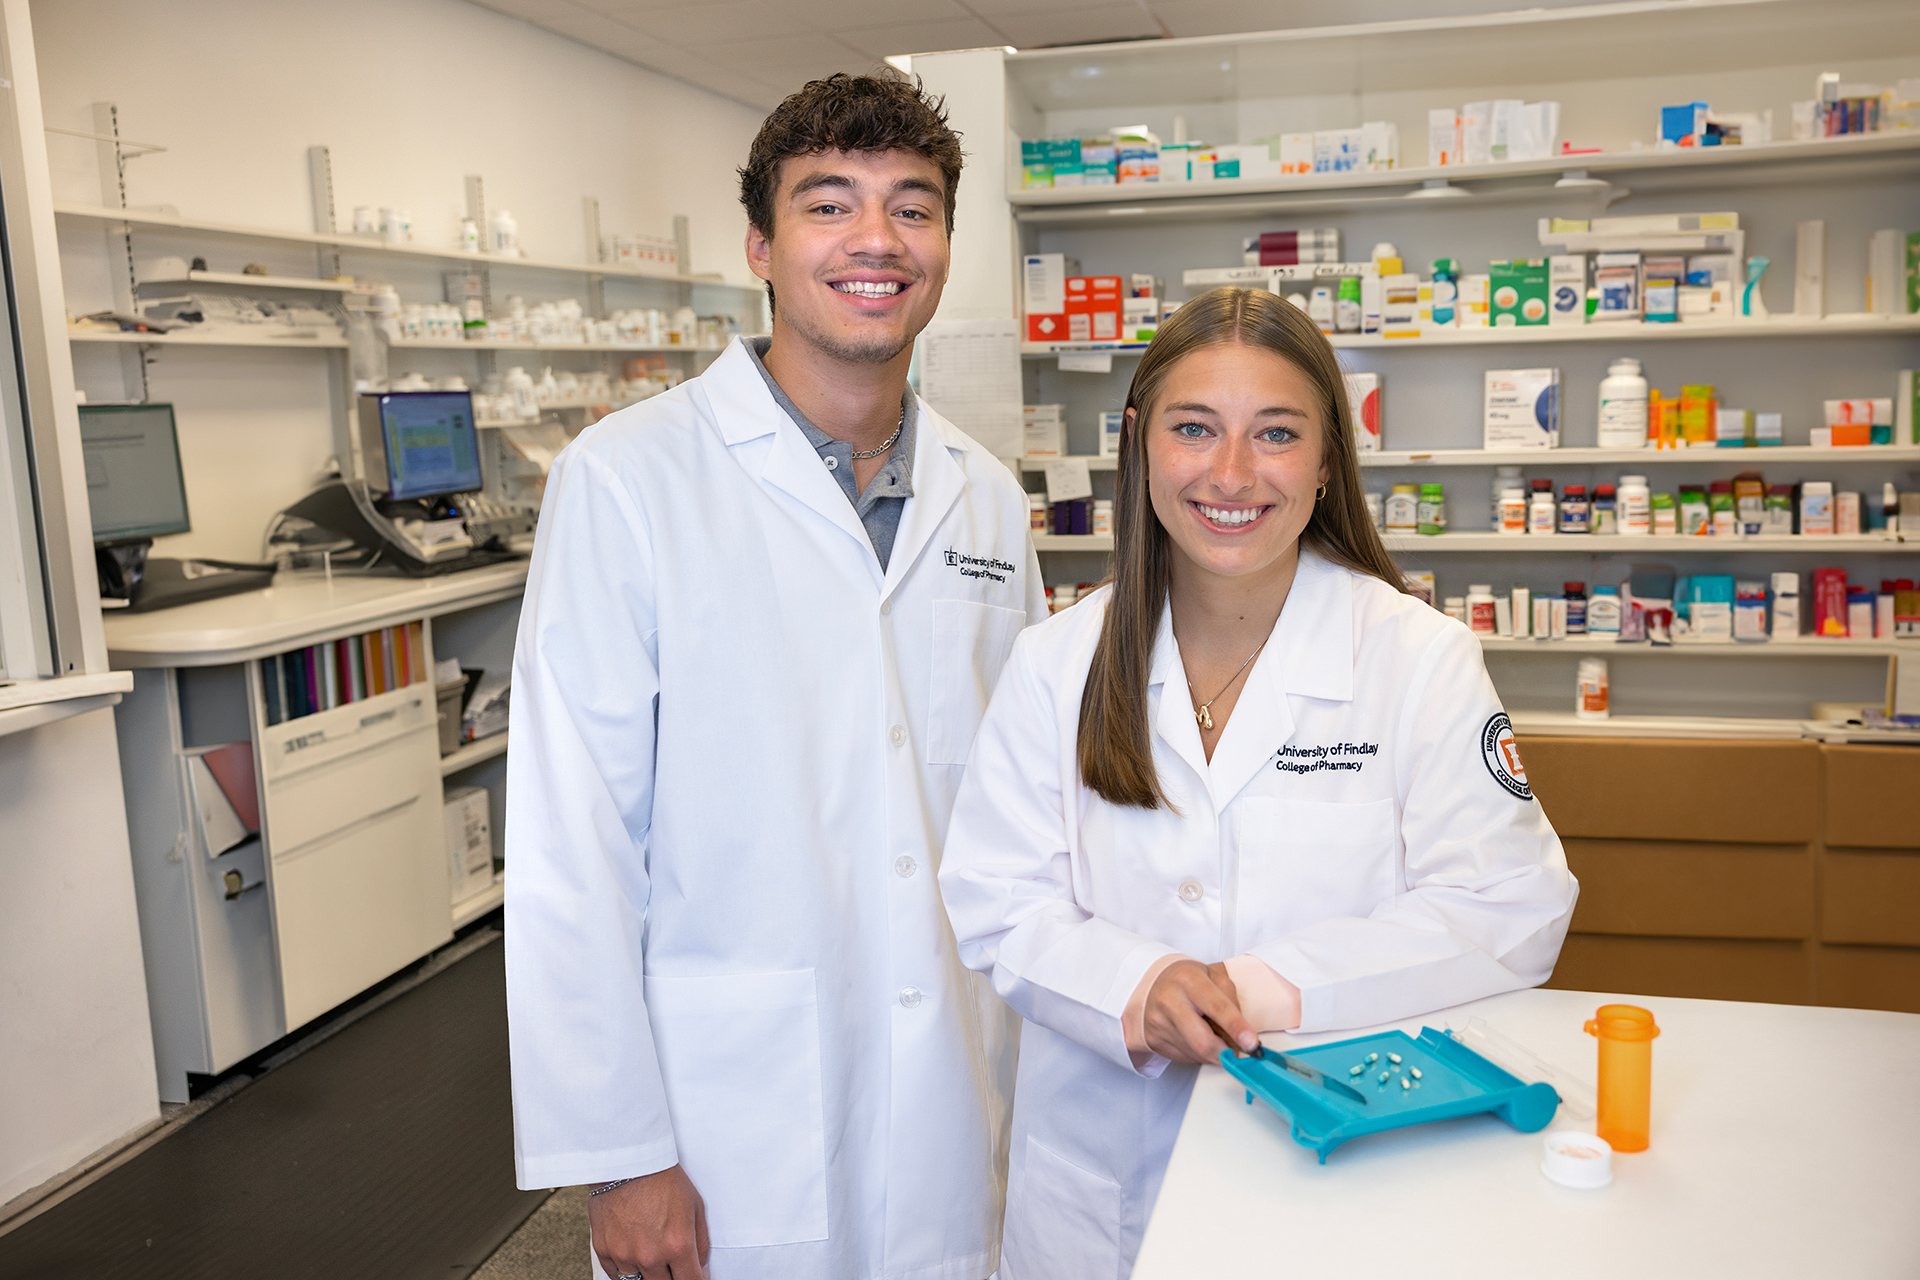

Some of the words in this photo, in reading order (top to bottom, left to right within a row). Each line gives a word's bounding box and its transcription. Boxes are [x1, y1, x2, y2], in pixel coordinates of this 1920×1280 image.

[959, 554, 990, 569] University
[960, 567, 980, 579] College
[1277, 744, 1329, 759] University
[1330, 743, 1342, 755] of
[1343, 742, 1379, 757] Findlay
[1276, 760, 1310, 775] College
[1310, 761, 1319, 772] of
[1319, 760, 1363, 773] Pharmacy
[1496, 769, 1524, 794] COLLEGE
